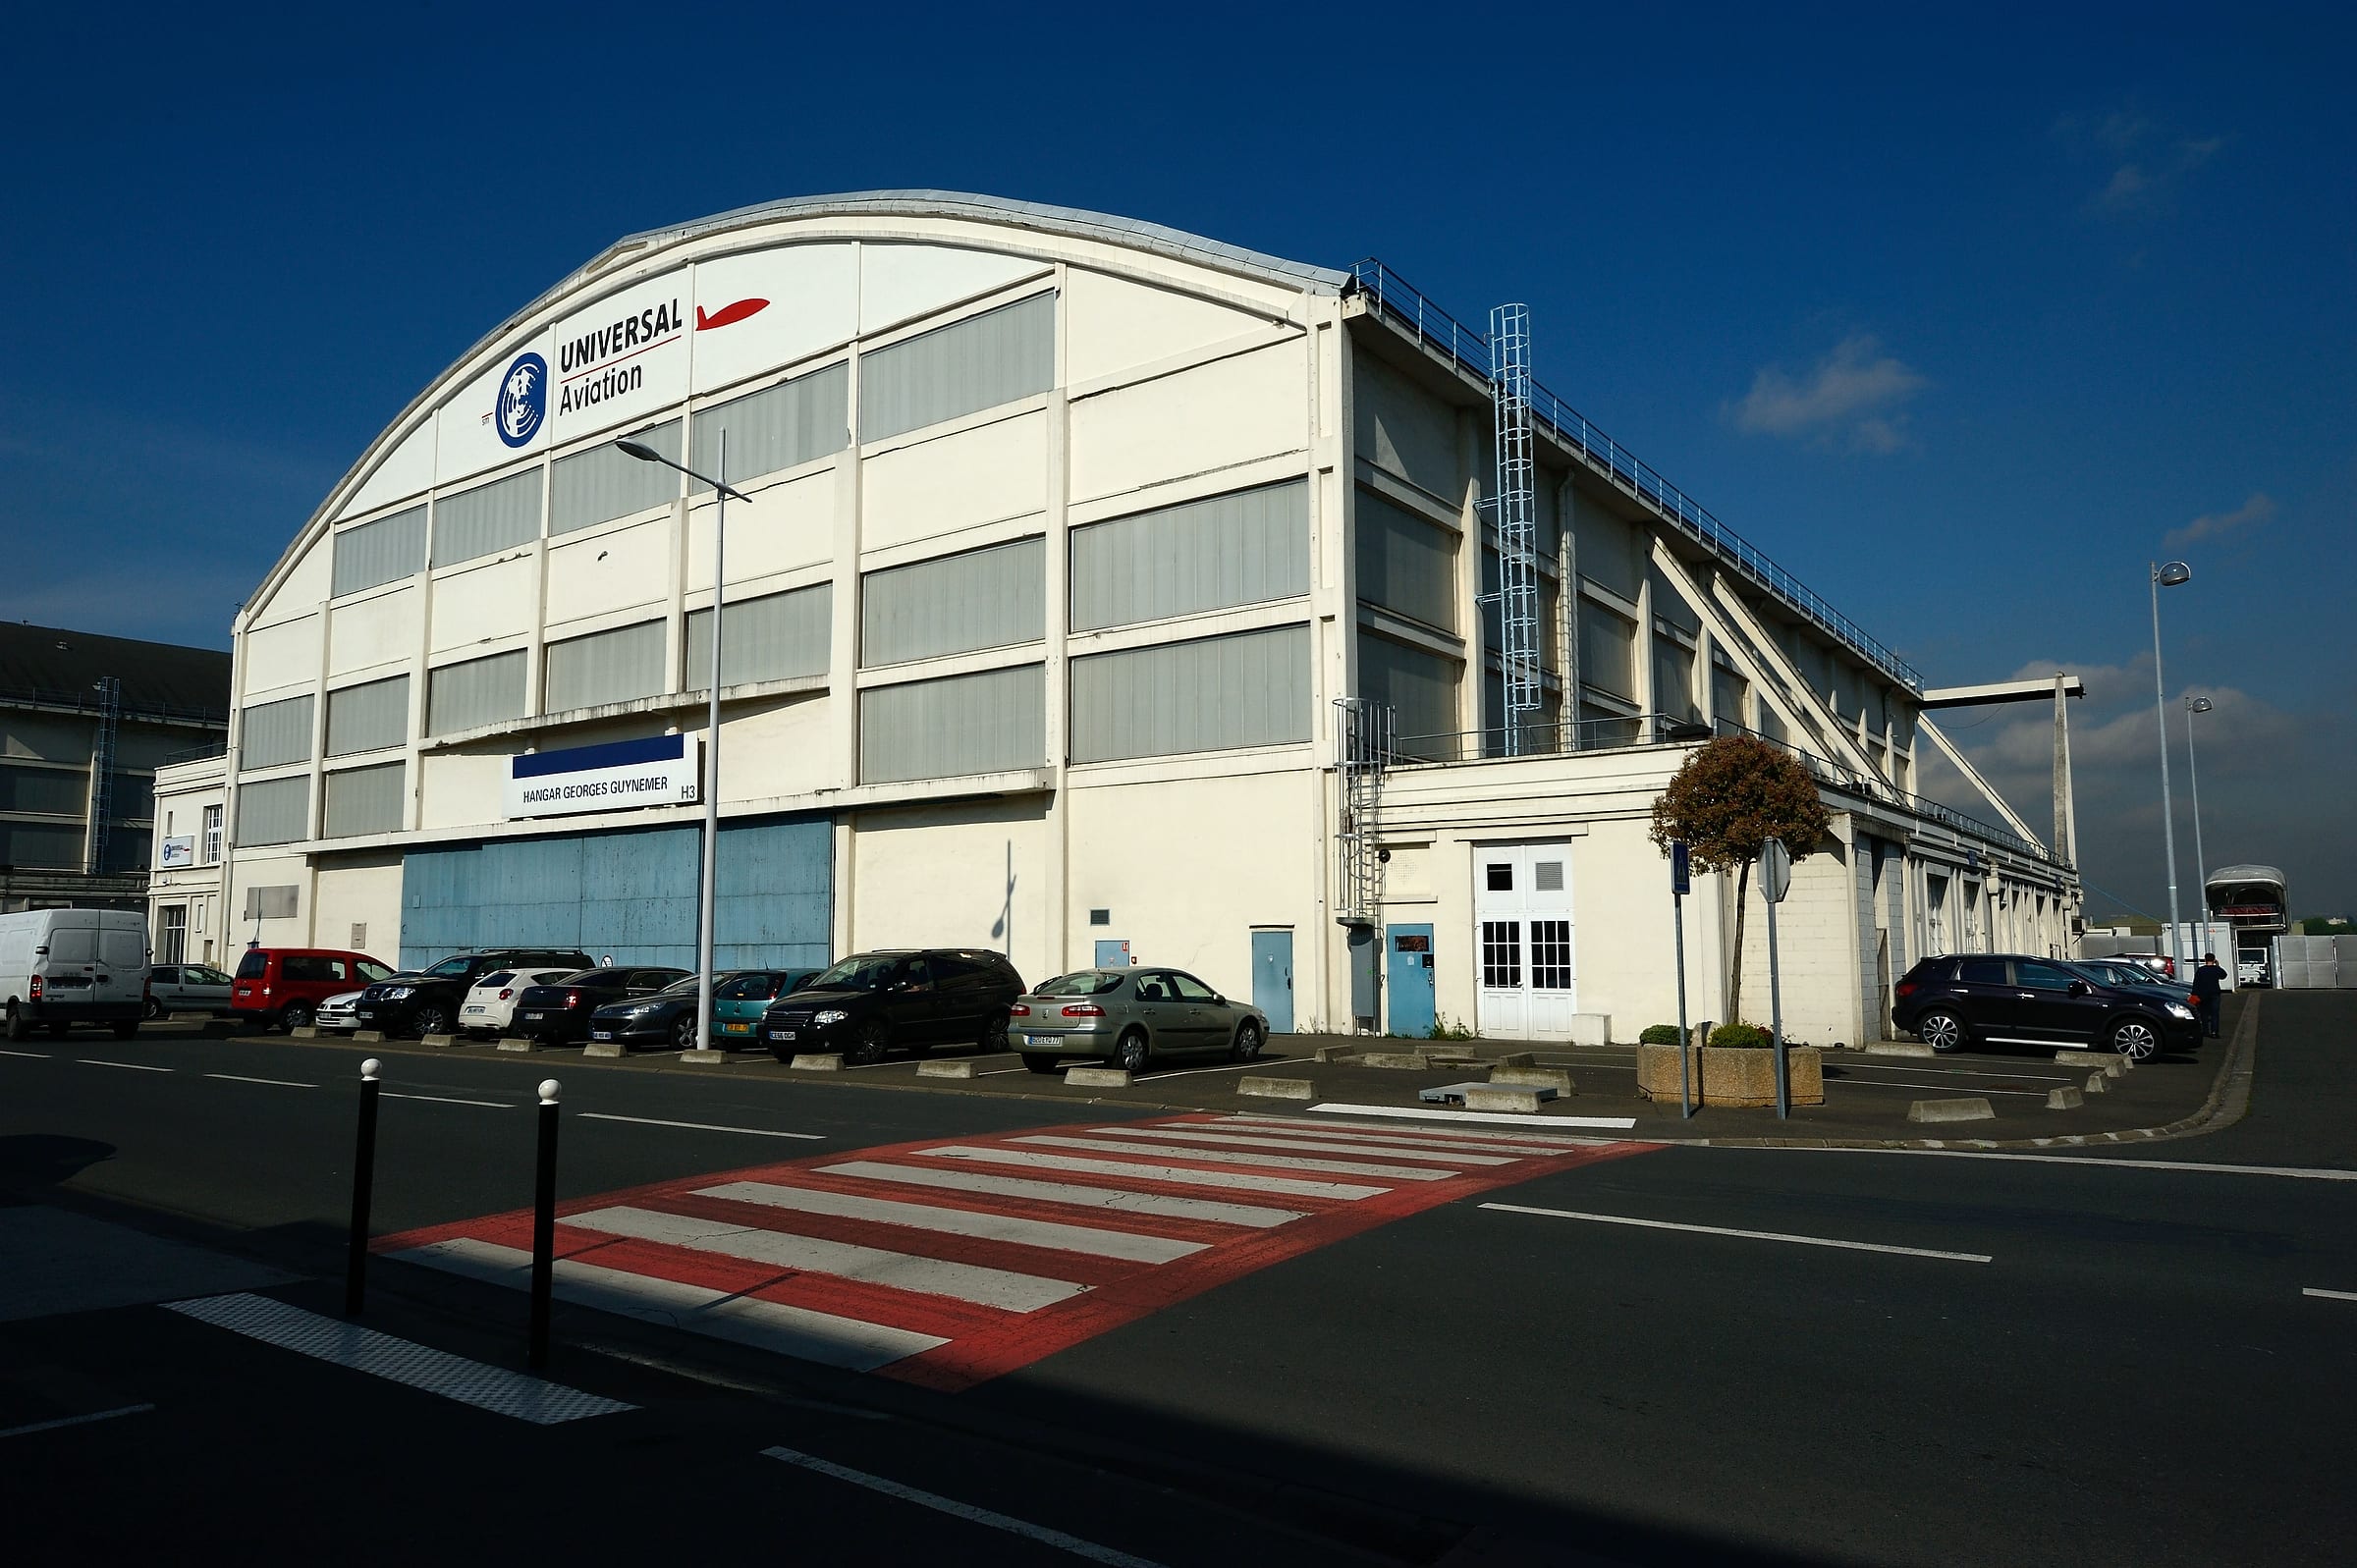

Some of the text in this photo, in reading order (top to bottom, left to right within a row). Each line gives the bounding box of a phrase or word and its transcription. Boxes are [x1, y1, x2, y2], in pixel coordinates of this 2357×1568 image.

[560, 297, 683, 373] UNIVERSAL
[560, 364, 642, 416] Aviation
[522, 776, 668, 804] HANGAR GEORGES GUYNEMER
[681, 784, 695, 800] H3
